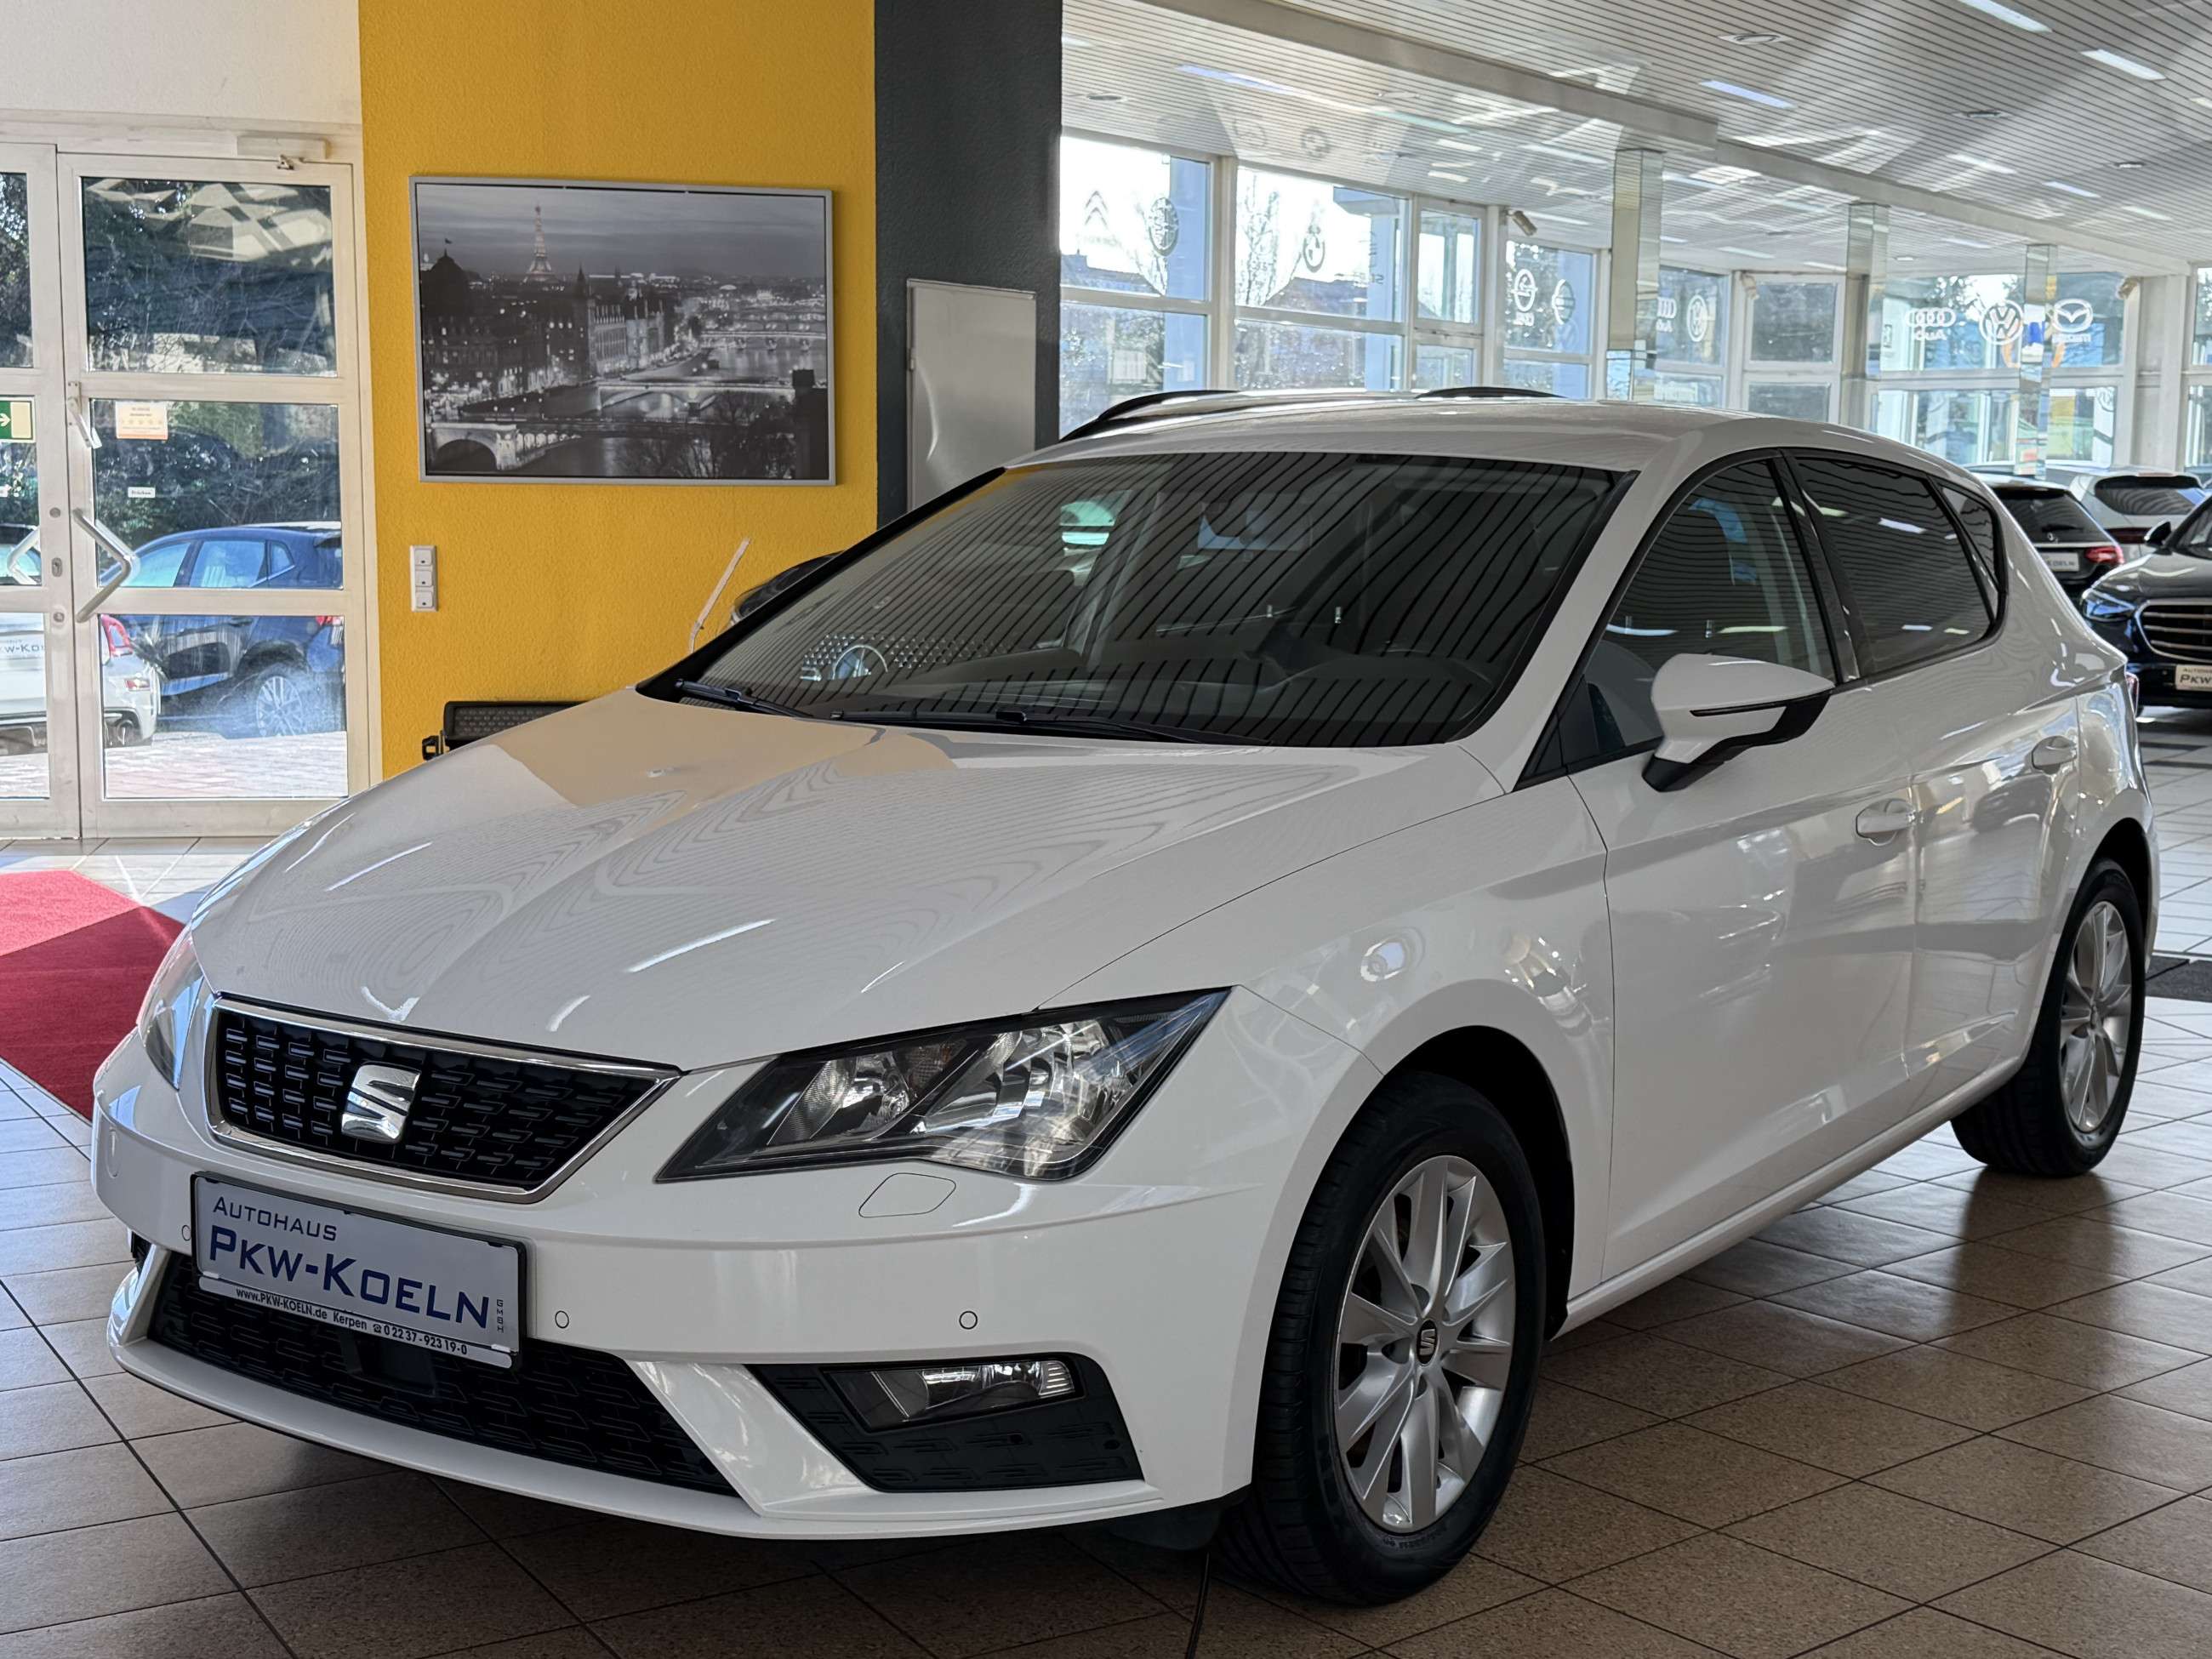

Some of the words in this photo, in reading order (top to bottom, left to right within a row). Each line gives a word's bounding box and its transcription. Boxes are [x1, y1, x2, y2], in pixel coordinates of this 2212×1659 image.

[213, 1196, 337, 1242] AUTOHAUS
[209, 1224, 490, 1329] PKW-KOELN
[236, 1287, 328, 1320] www.PKW-KOELN.de
[333, 1310, 368, 1331] Kerpen
